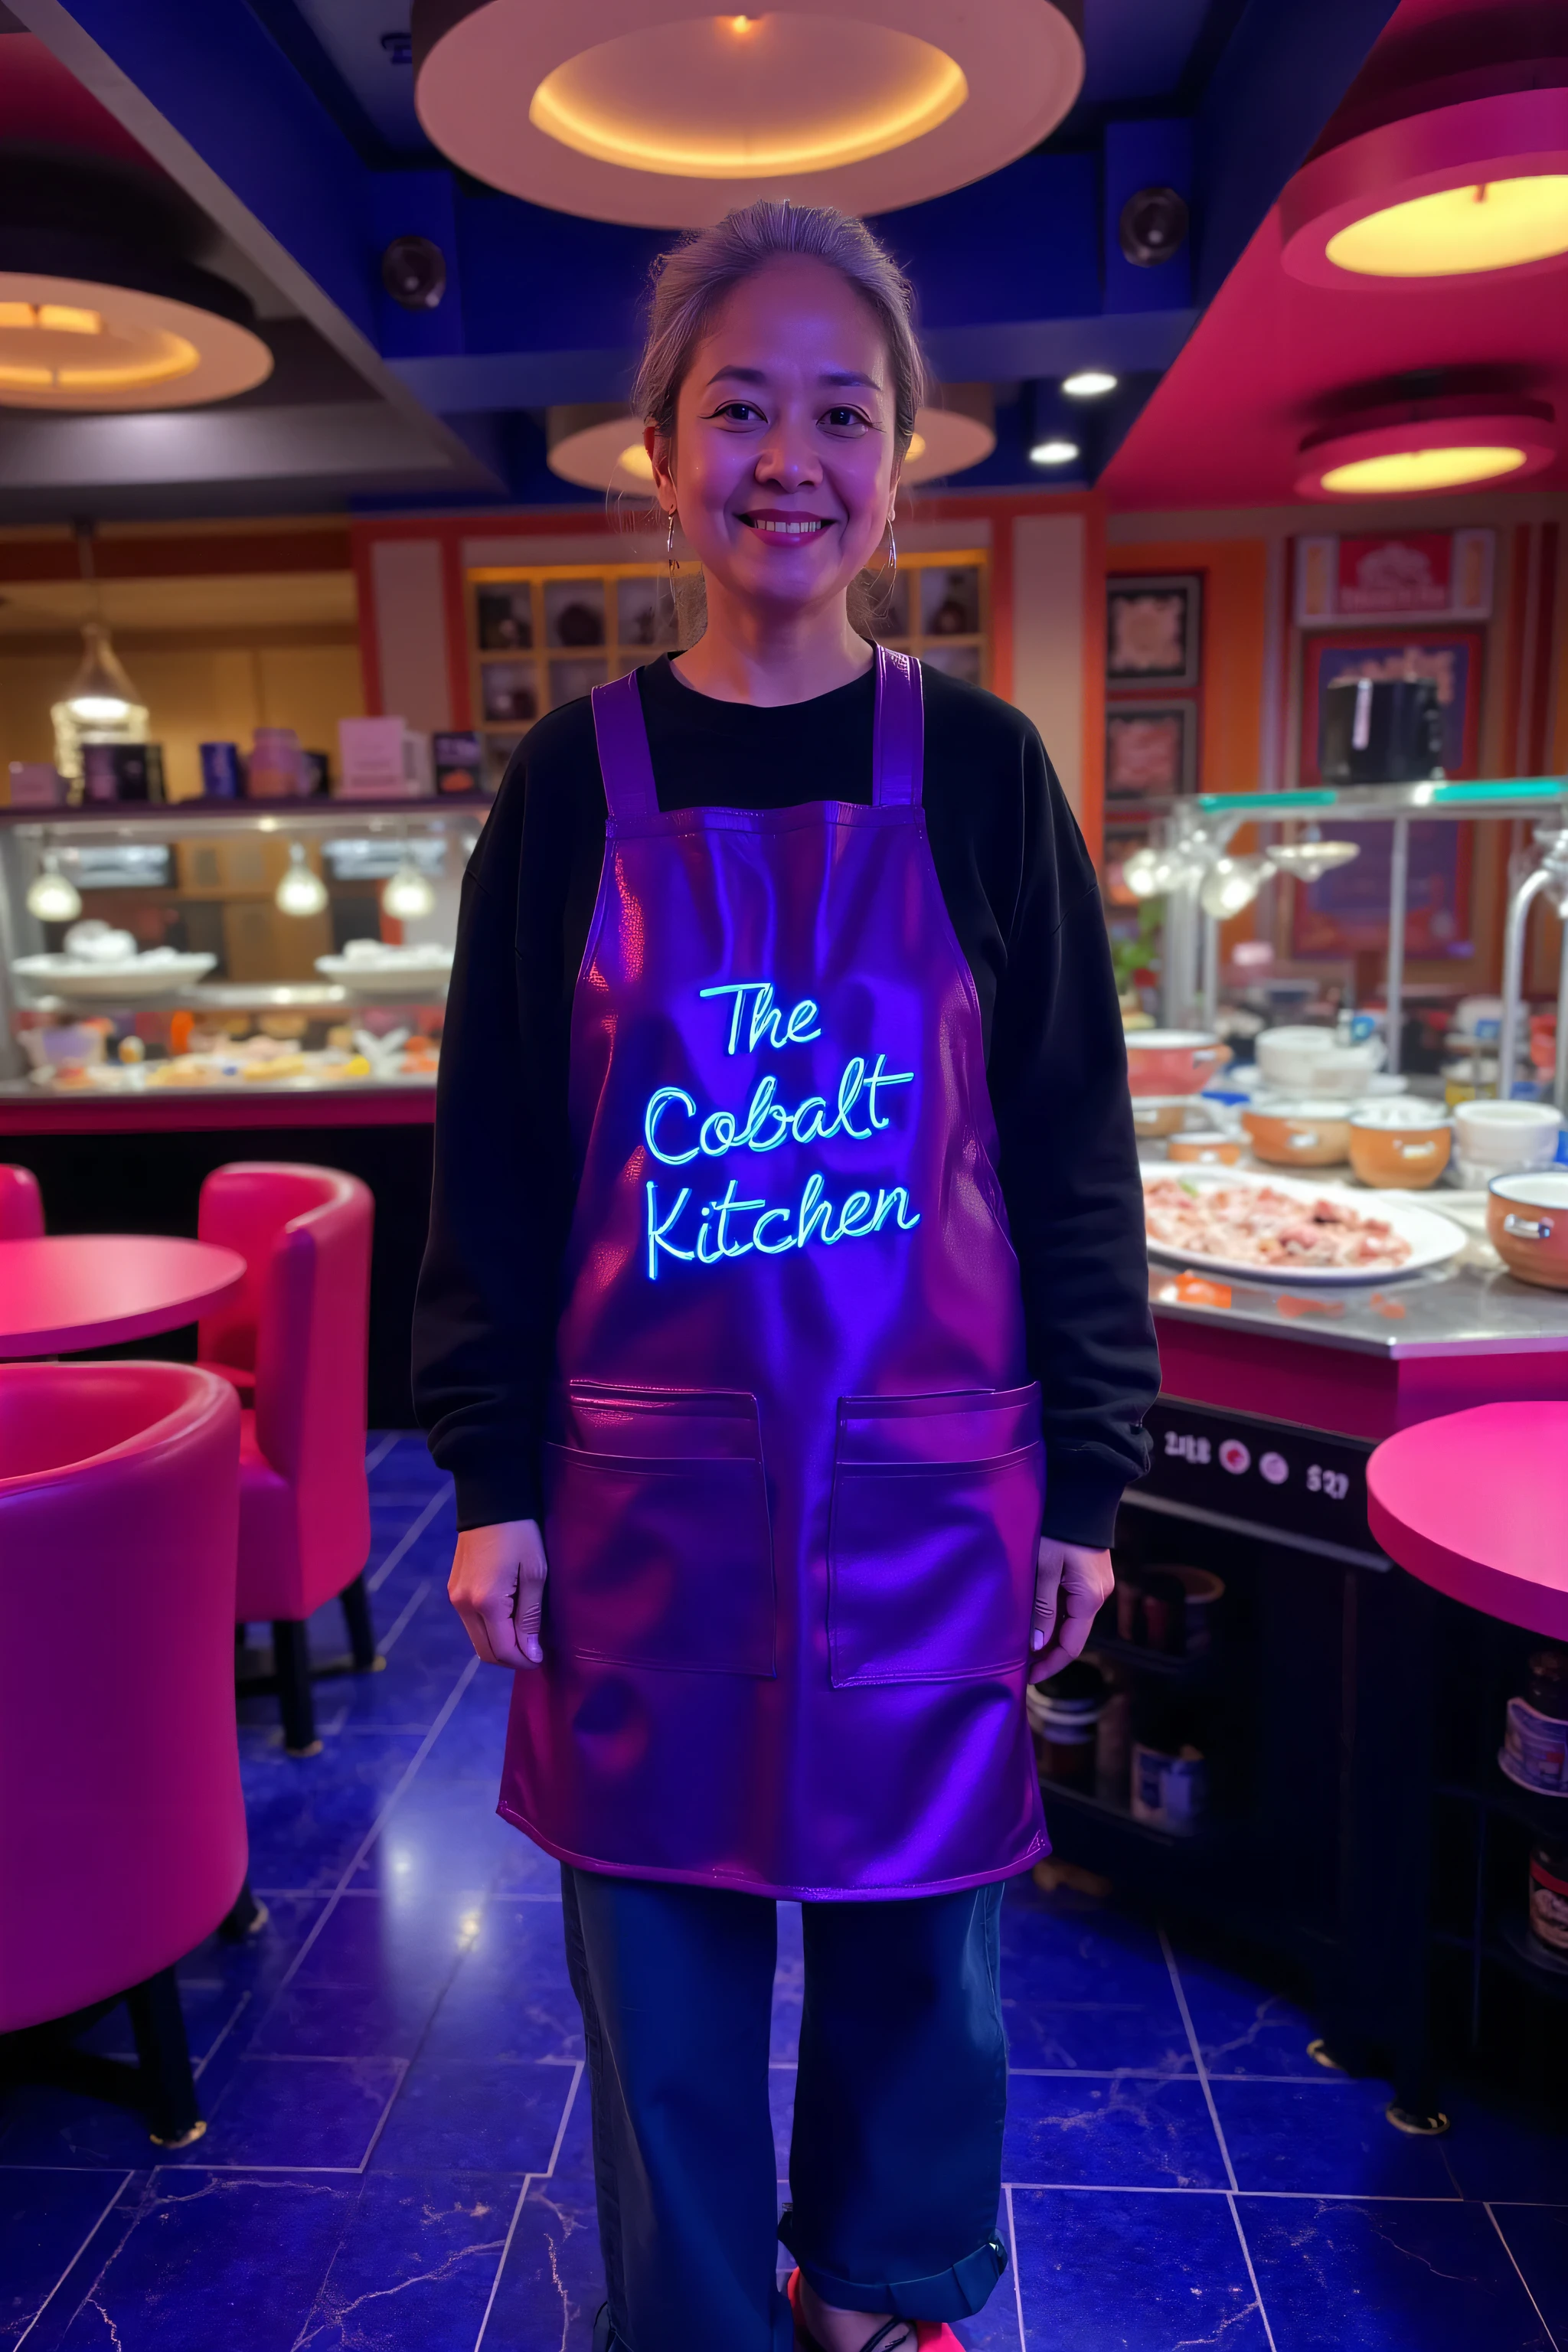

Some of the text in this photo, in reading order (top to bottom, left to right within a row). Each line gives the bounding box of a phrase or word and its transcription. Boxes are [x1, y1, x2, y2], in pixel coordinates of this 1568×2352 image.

[700, 983, 822, 1055] The
[645, 1054, 915, 1165] Cobalt
[646, 1171, 921, 1280] Kitchen
